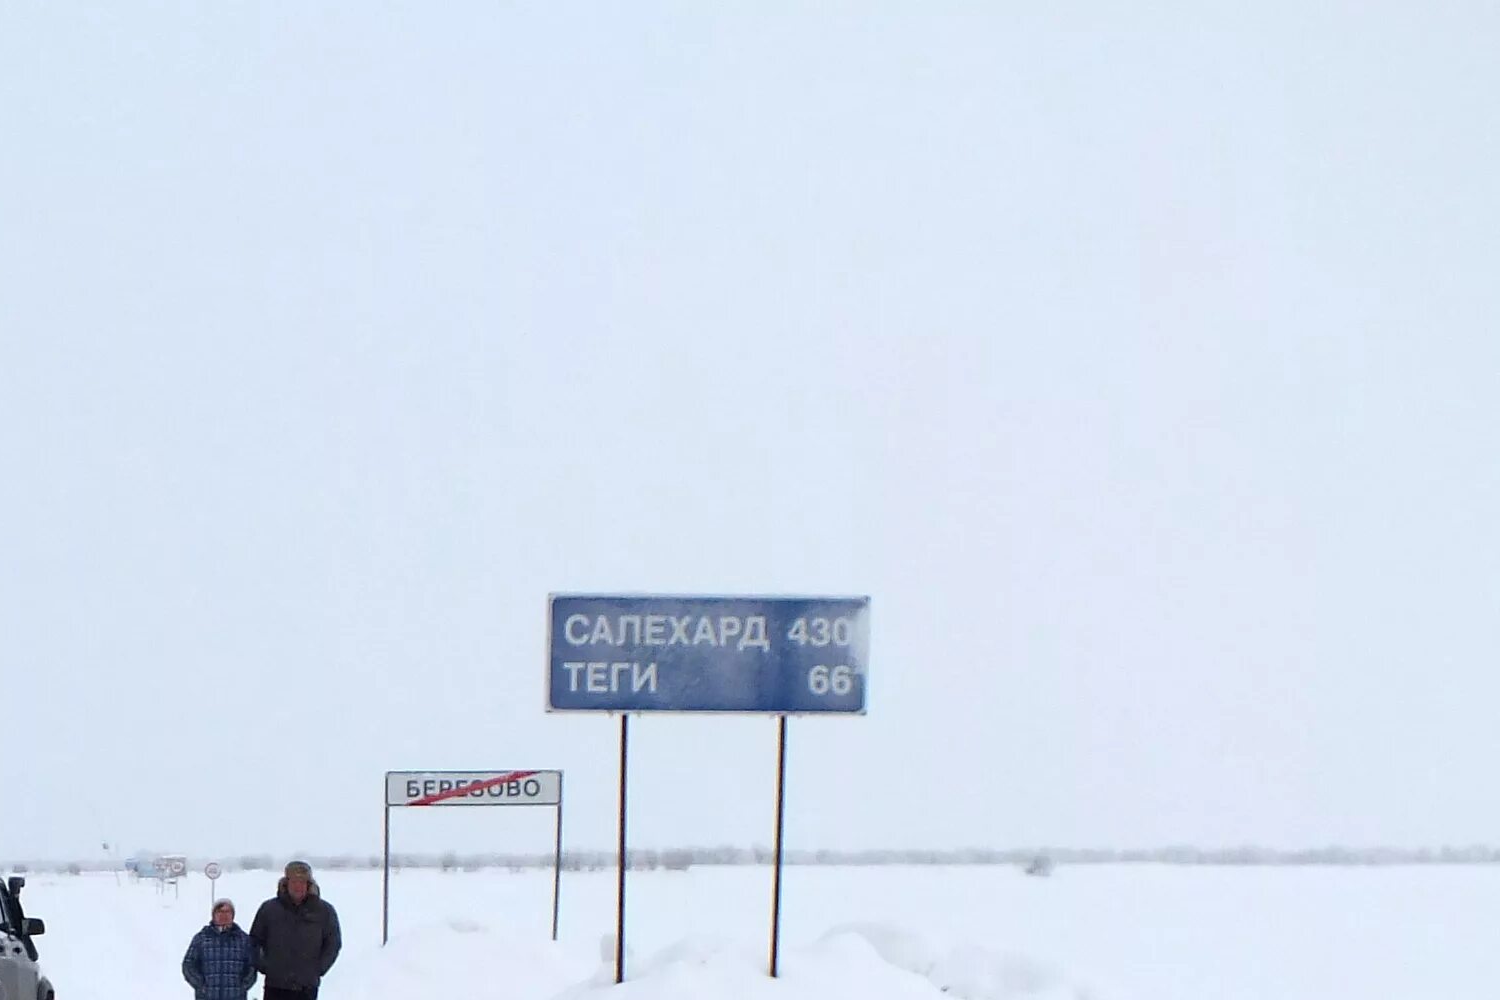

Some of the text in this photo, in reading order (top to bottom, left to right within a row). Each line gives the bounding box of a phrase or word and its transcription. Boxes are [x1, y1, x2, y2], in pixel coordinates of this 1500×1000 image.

[564, 614, 851, 652] САЛЕХАРД 430
[563, 662, 852, 695] ТЕГИ 66
